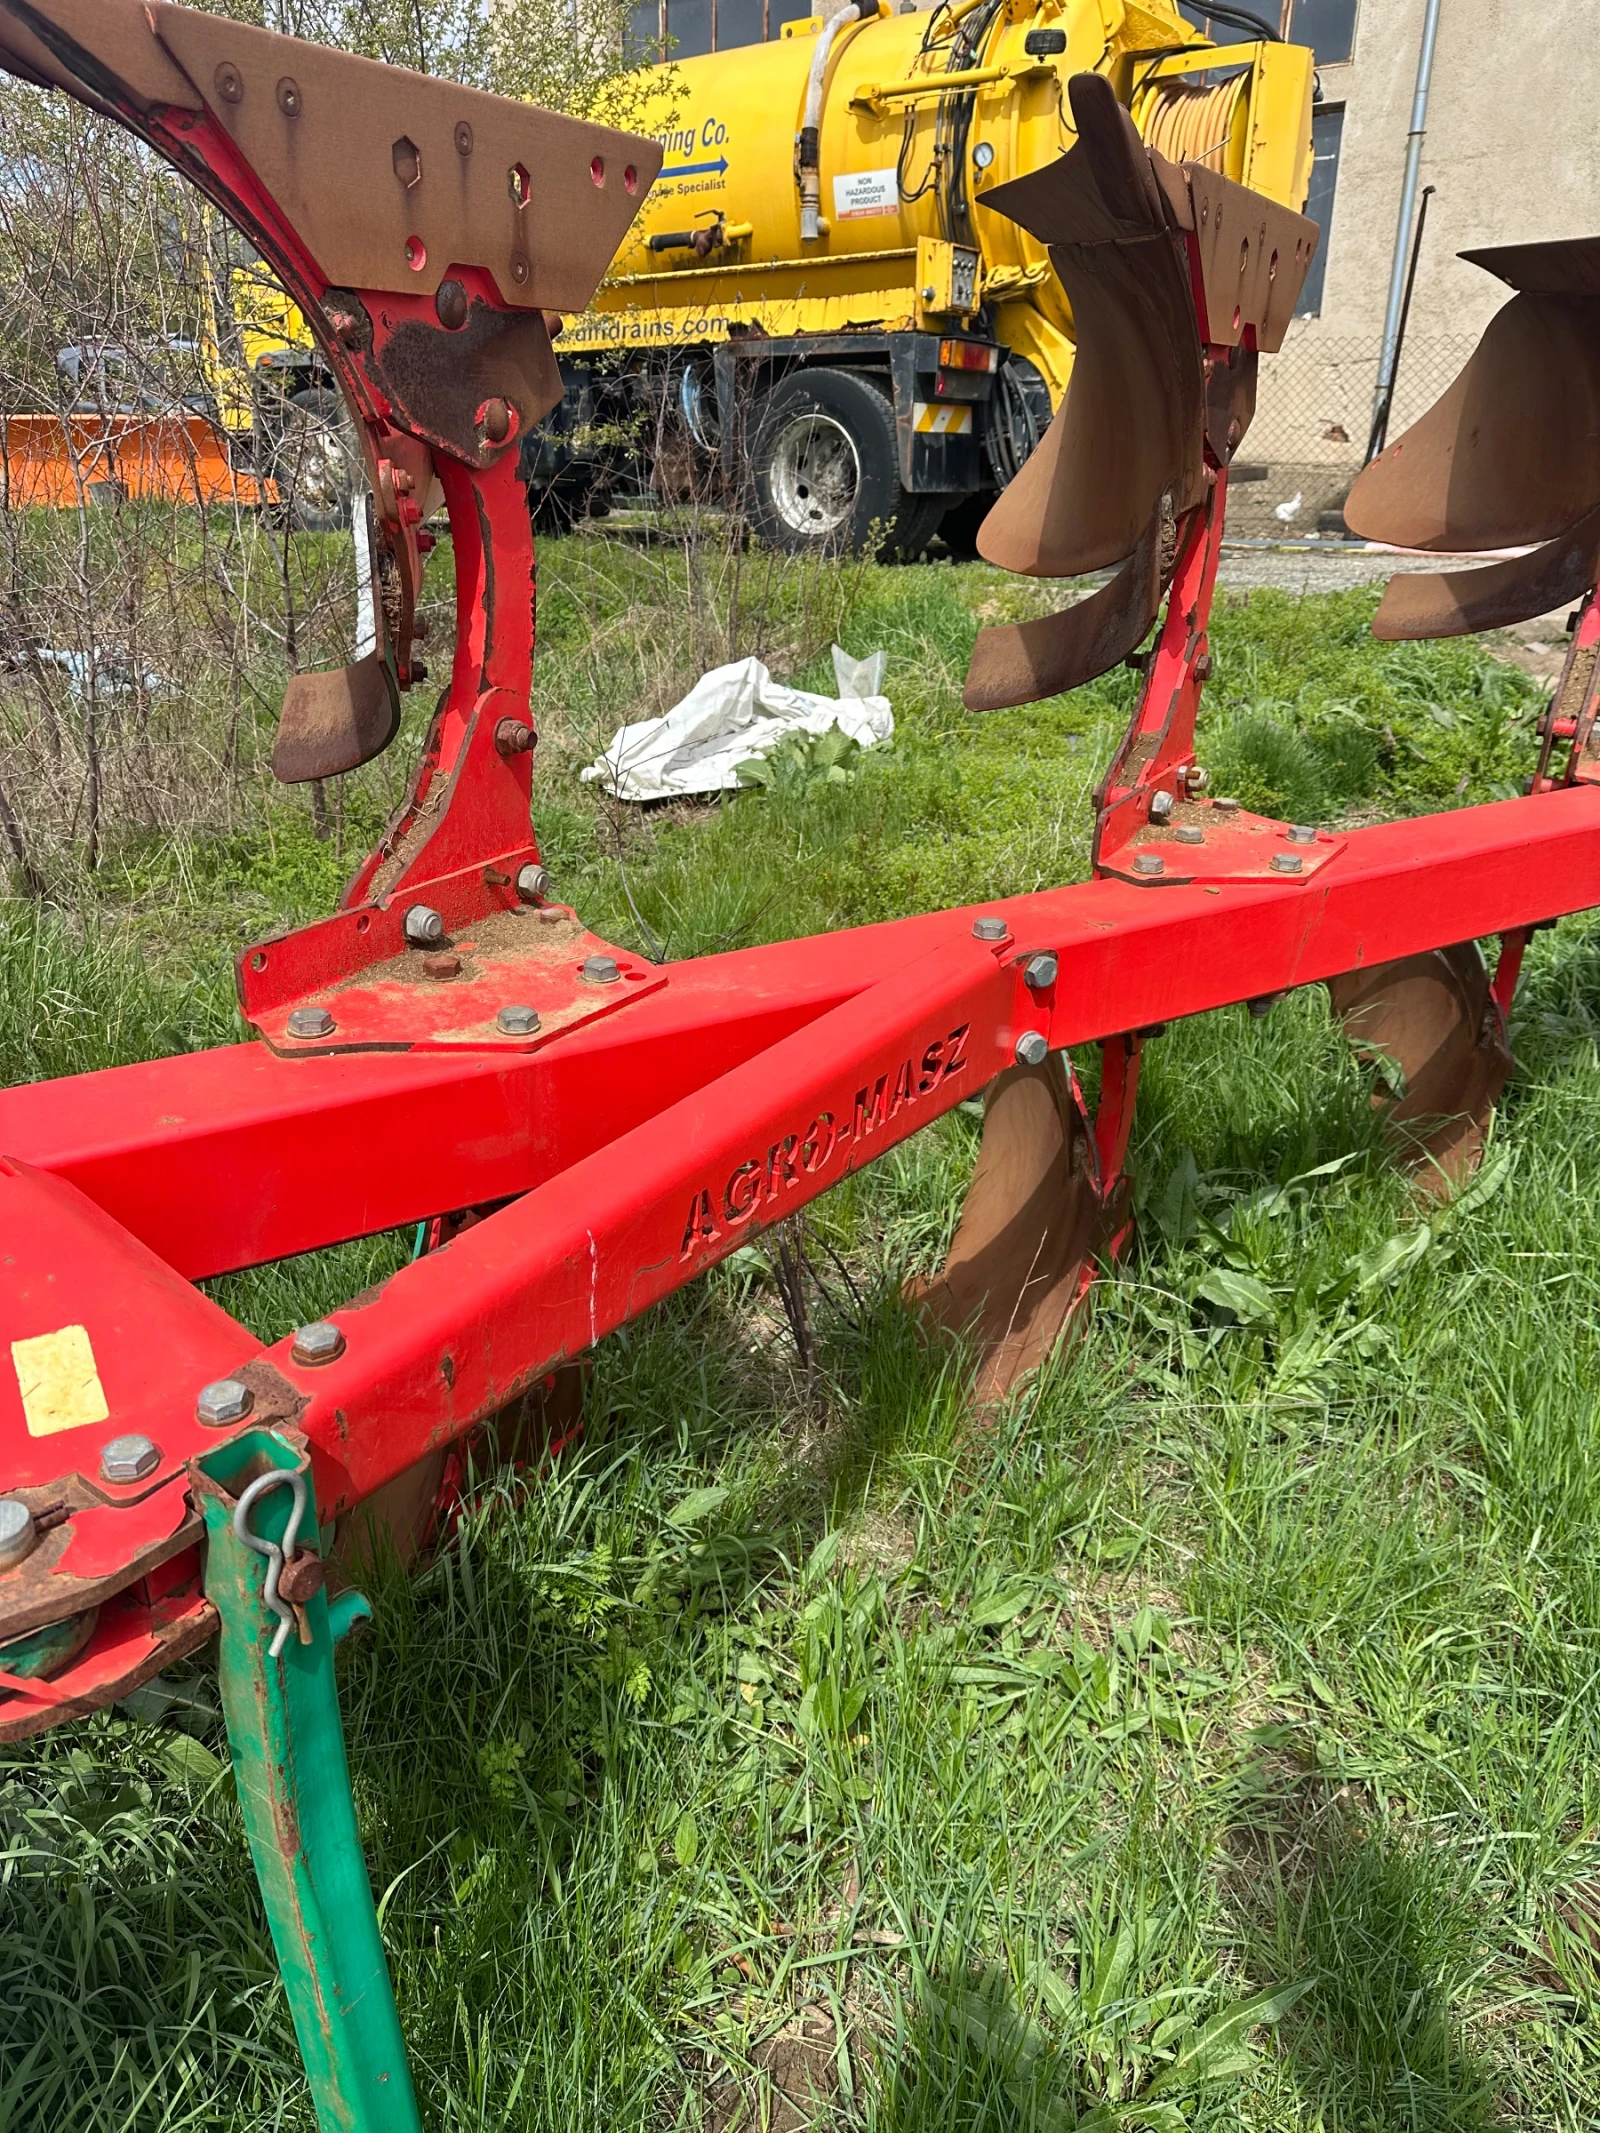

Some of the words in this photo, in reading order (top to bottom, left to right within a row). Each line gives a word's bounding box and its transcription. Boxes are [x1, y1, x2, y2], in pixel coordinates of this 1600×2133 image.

[702, 117, 729, 147] Co.
[677, 179, 726, 197] Specialist
[857, 177, 872, 185] NON
[845, 185, 885, 196] HAZARDOUS
[851, 195, 881, 205] PRODUCT
[679, 1022, 971, 1263] AGRO-MASZ
